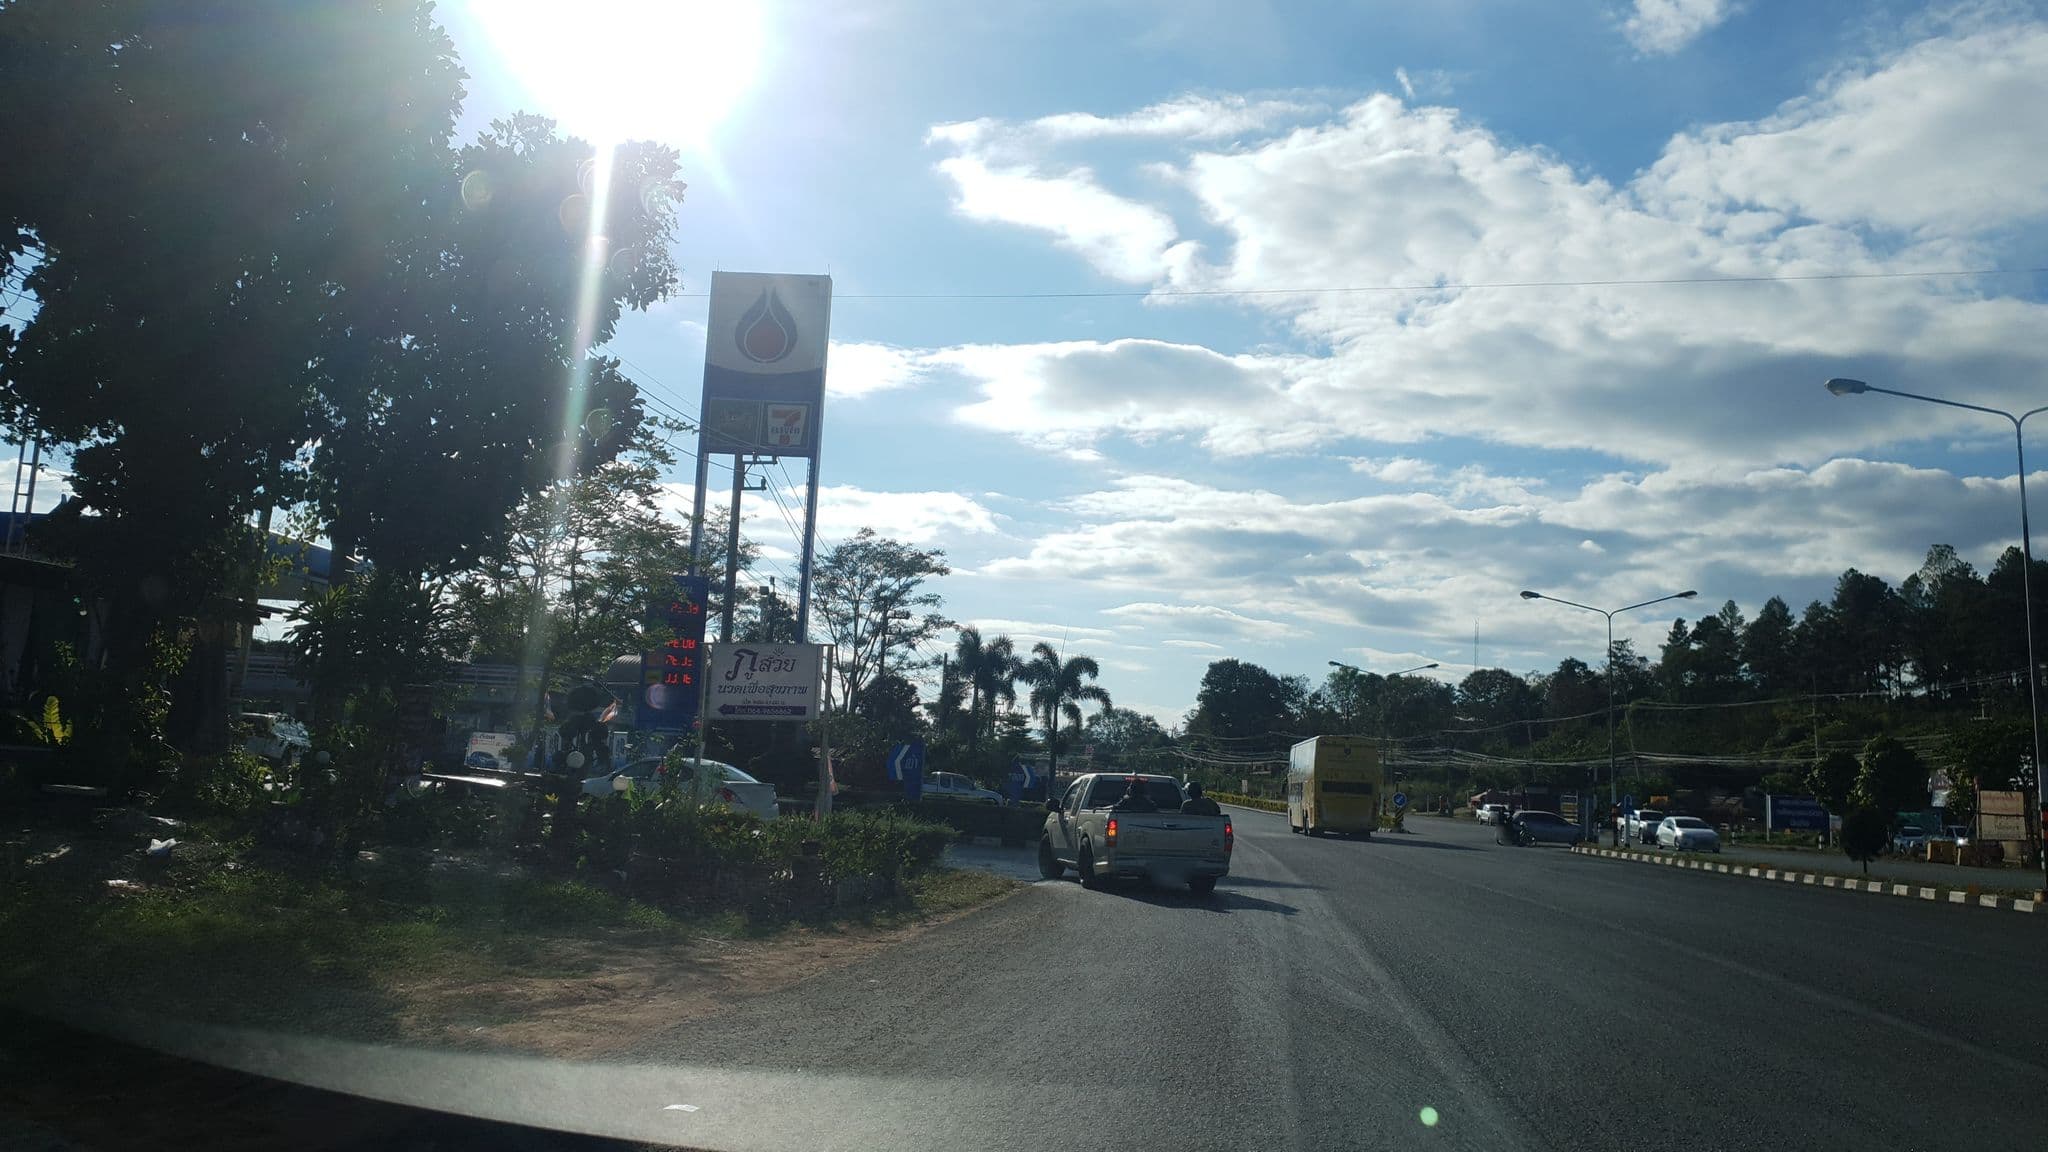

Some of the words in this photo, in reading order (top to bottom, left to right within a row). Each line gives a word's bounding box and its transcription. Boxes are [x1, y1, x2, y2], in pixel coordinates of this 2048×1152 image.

[725, 648, 797, 680] ภูสวย
[718, 681, 809, 697] นวดเพื่อสุขภาพ
